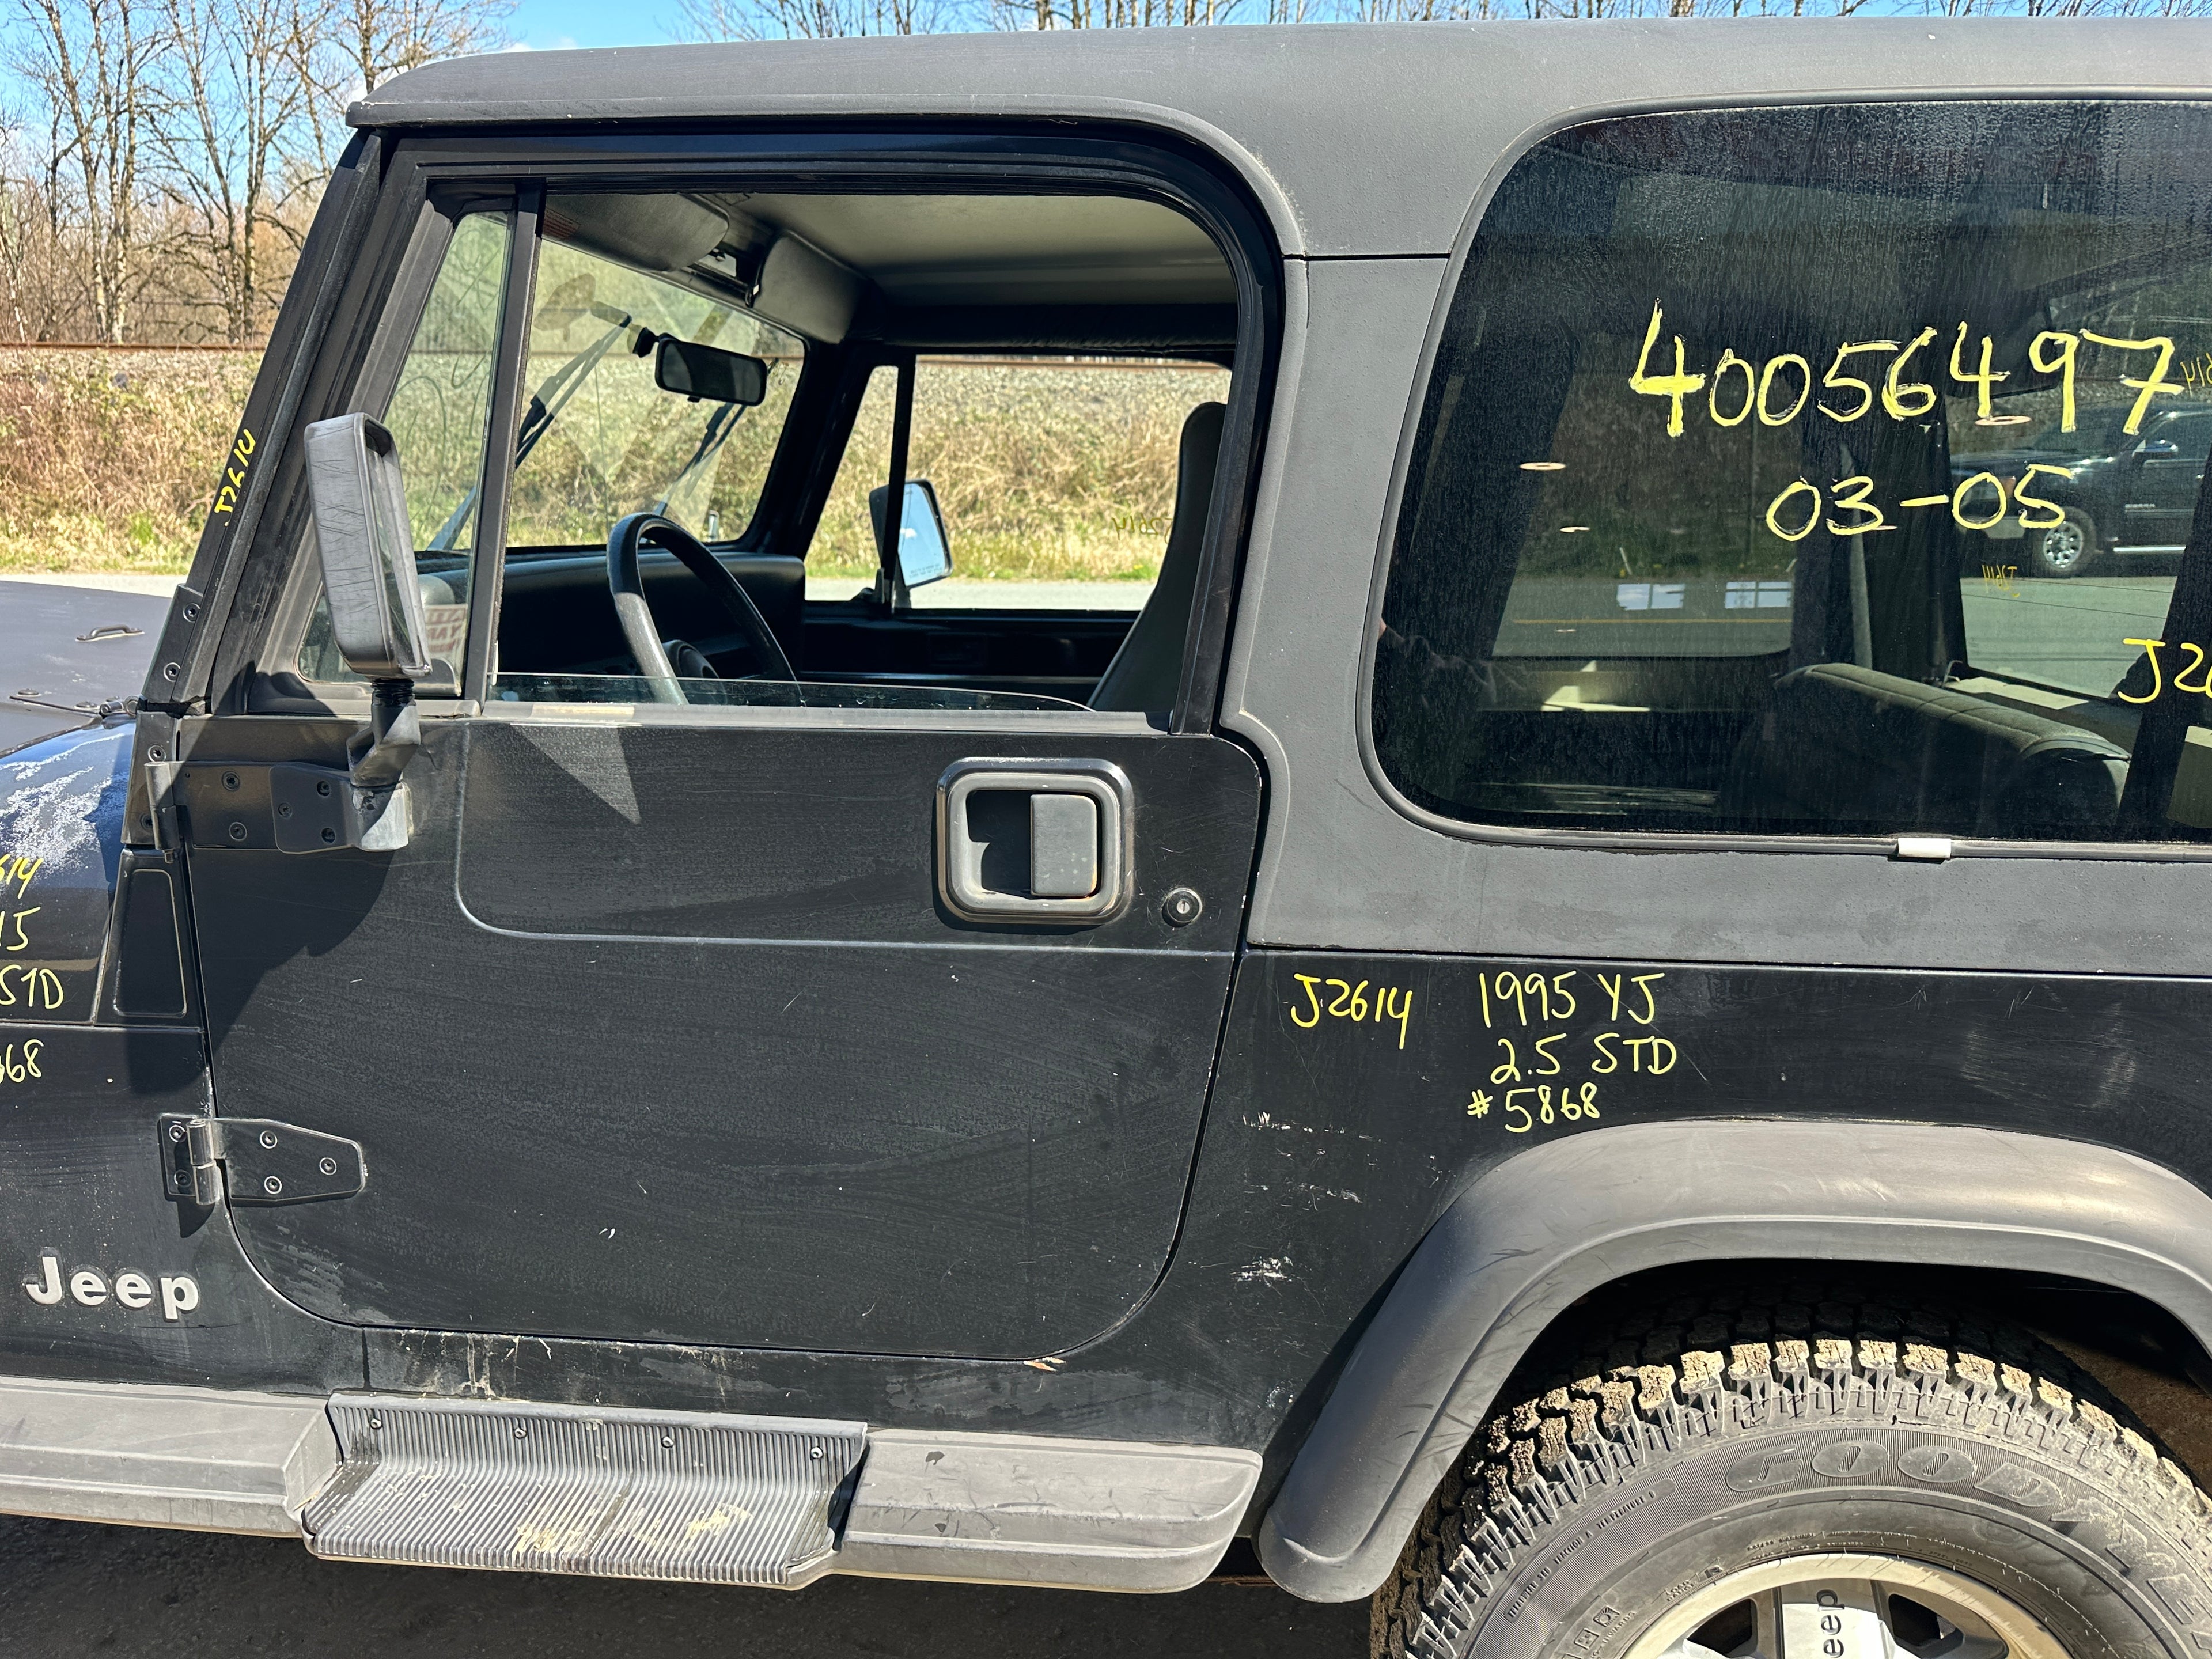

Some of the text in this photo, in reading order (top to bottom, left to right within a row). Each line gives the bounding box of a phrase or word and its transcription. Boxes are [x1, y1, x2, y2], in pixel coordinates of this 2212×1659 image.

[1629, 298, 2184, 437] 40056497
[1766, 464, 2073, 541] 03-05
[1291, 973, 1413, 1050] J2614
[1479, 970, 1665, 1028] 1995 YJ
[1491, 1033, 1677, 1084] 2.5 STD
[24, 1253, 199, 1321] Jeep
